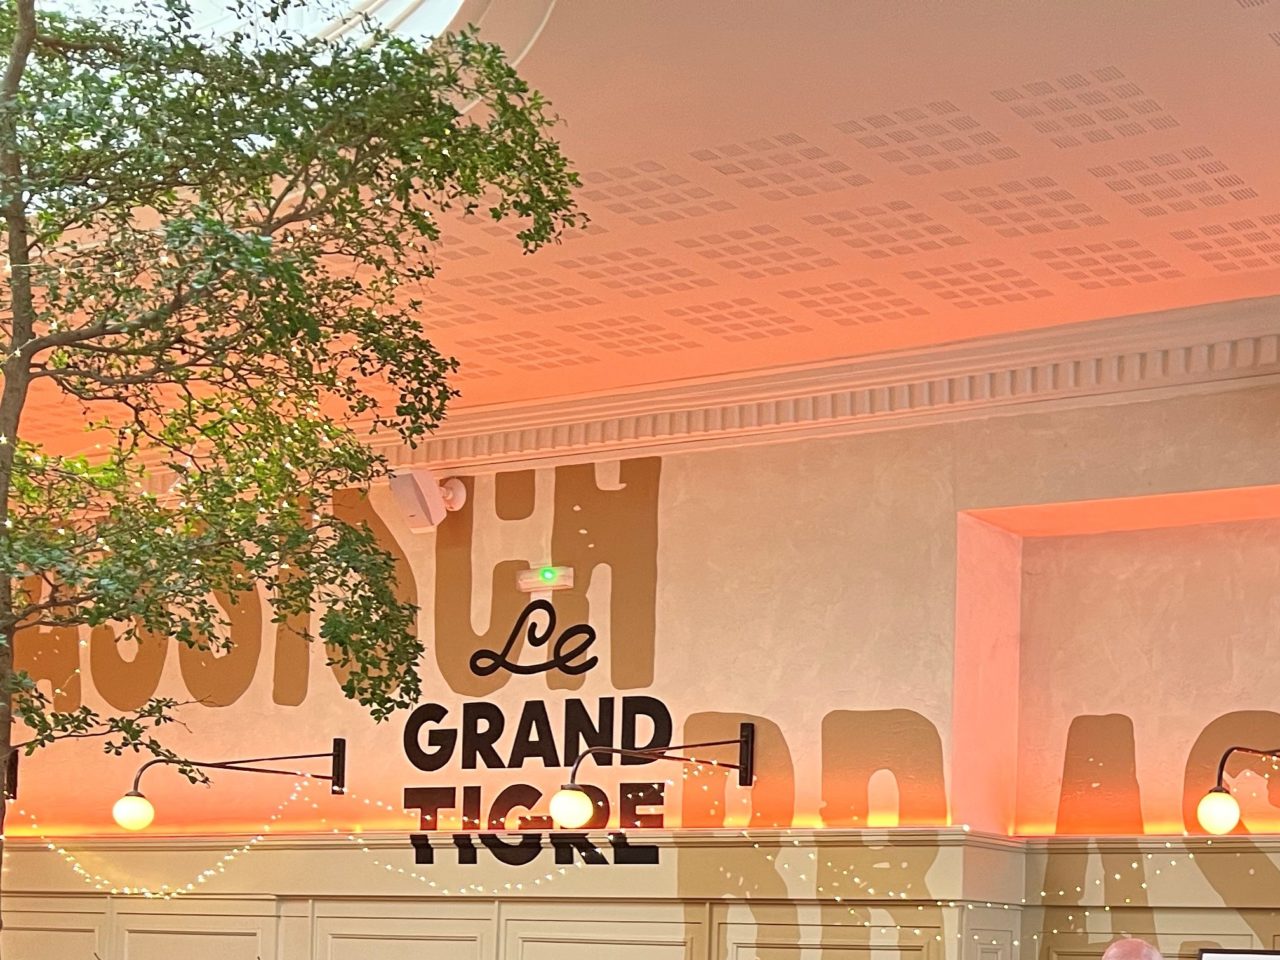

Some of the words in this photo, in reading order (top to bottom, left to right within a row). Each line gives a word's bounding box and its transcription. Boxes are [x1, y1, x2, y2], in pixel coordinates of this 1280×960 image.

[469, 599, 599, 677] Le
[403, 695, 673, 772] GRAND
[403, 782, 666, 866] TIGRE
